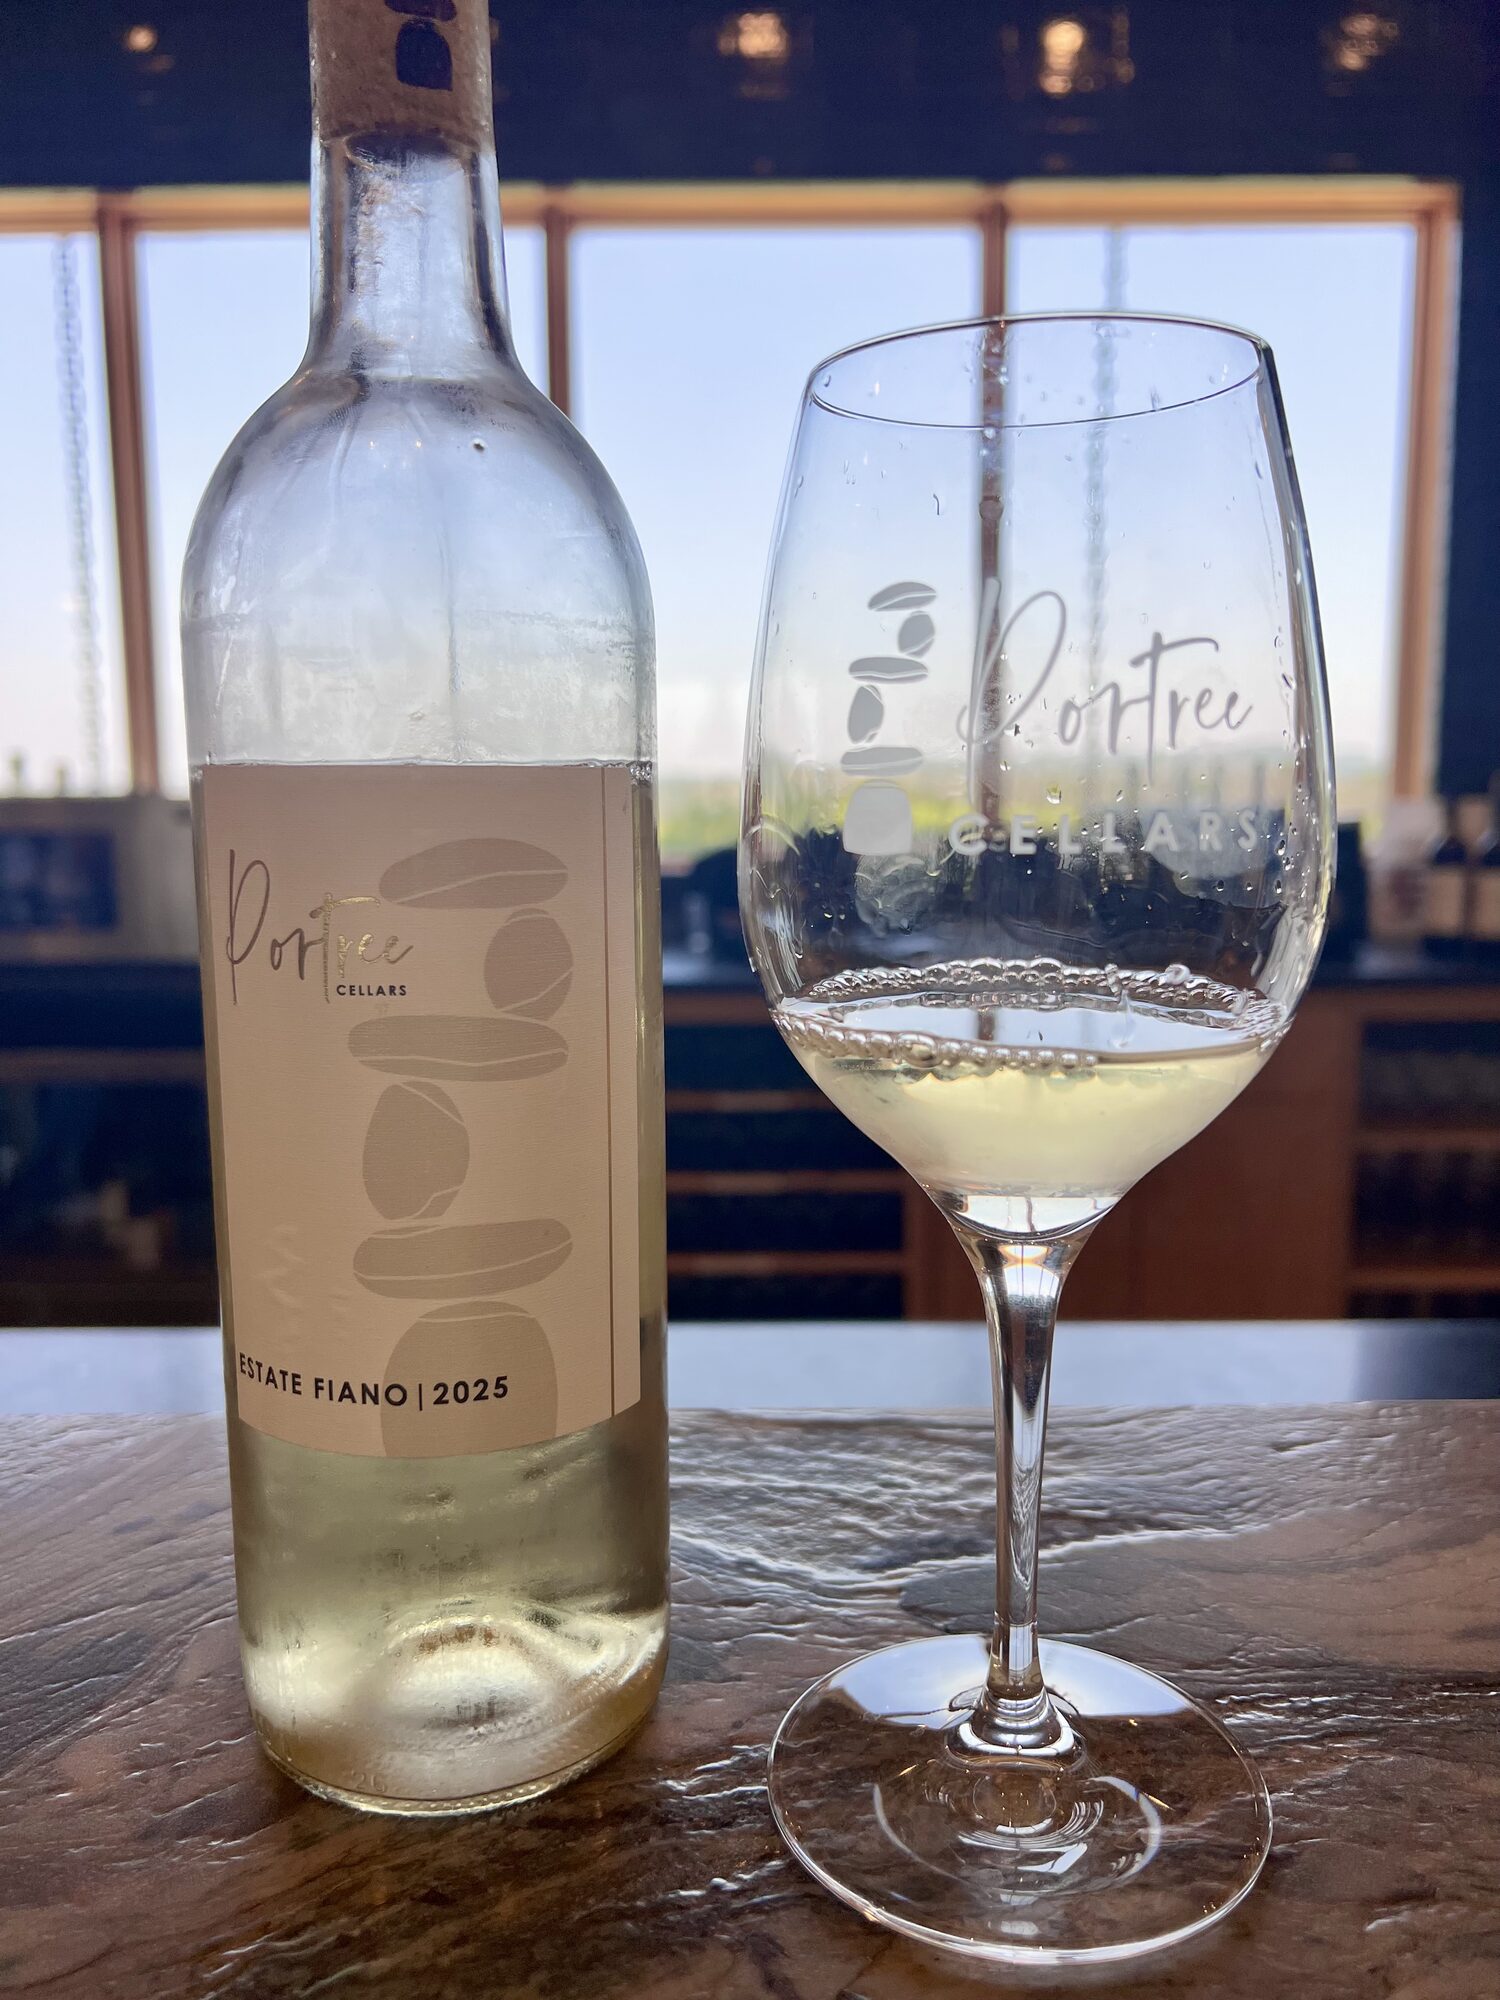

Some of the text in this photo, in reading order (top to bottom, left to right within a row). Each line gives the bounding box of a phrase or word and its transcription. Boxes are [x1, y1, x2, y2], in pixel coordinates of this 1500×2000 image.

[956, 578, 1253, 806] Portree
[948, 810, 1260, 856] CELLARS
[226, 848, 414, 1006] Portree
[336, 984, 408, 997] CELLARS
[239, 1351, 303, 1396] ESTATE
[314, 1376, 408, 1407] FIANO
[432, 1375, 509, 1405] 2025
